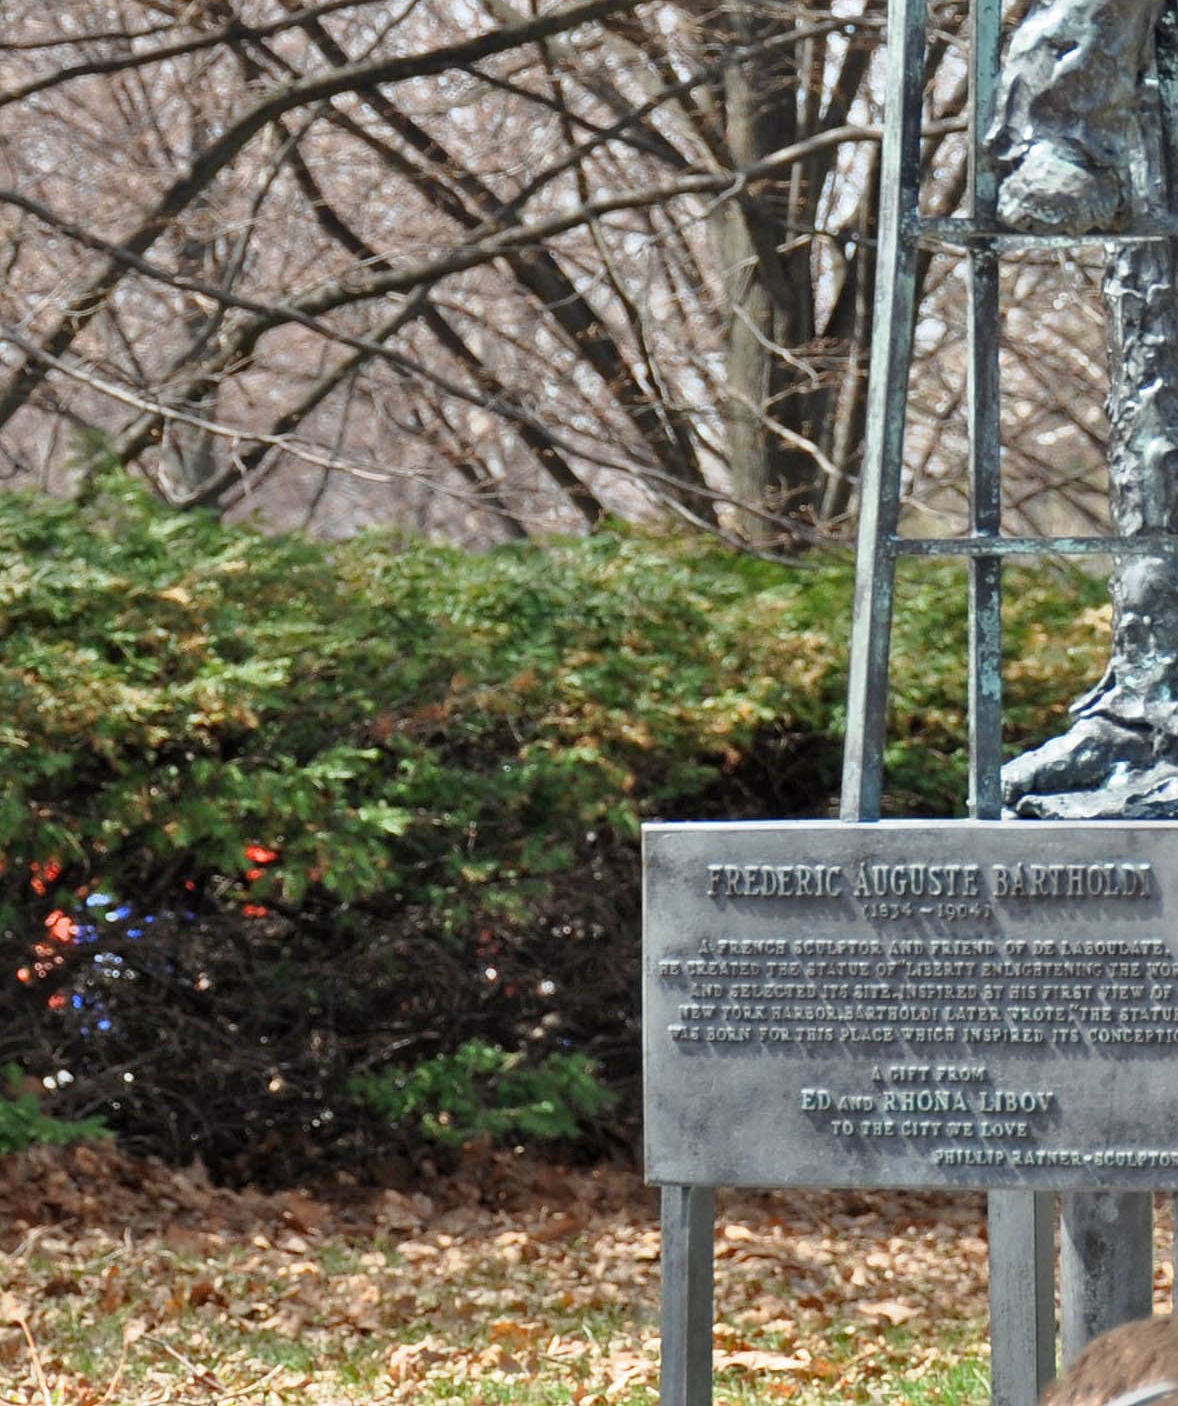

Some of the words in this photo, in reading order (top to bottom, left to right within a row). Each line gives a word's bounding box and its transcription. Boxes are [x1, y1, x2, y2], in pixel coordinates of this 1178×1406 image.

[707, 864, 842, 896] FREDERIC
[853, 862, 979, 896] AUGUSTE
[992, 862, 1151, 896] BARTHOLDI
[718, 939, 786, 955] FRENCH
[793, 939, 881, 955] SCULPTOR
[887, 939, 924, 955] AND
[930, 939, 996, 955] FRIEND
[1004, 940, 1025, 955] OF
[1032, 940, 1055, 955] DE
[658, 961, 681, 977] HE
[686, 961, 761, 977] CREATED
[767, 962, 799, 977] THE
[805, 961, 869, 977] STATUE
[875, 962, 897, 977] OF
[981, 961, 1102, 977] ENLIGHTENING
[1107, 961, 1140, 977] THE
[689, 983, 723, 999] AND
[730, 983, 816, 999] SELECTED
[821, 984, 848, 999] ITS
[983, 984, 1003, 999] BY
[1008, 984, 1036, 999] HIS
[1042, 984, 1093, 999] FIRST
[1098, 984, 1144, 999] VIEW
[1151, 984, 1173, 999] OF
[678, 1004, 716, 1020] NEW
[721, 1005, 765, 1020] YORK
[943, 1005, 1000, 1021] LATER
[667, 1025, 699, 1042] WAS
[706, 1027, 750, 1042] BORN
[759, 1027, 793, 1042] FOR
[796, 1027, 833, 1042] THIS
[840, 1027, 893, 1042] PLACE
[901, 1027, 955, 1042] WHICH
[962, 1027, 1043, 1043] INSPIRED
[1052, 1028, 1079, 1043] ITS
[871, 1066, 881, 1082] A
[889, 1066, 930, 1082] GIFT
[936, 1066, 986, 1082] FROM
[801, 1089, 832, 1111] ED
[837, 1096, 873, 1112] AND
[883, 1090, 967, 1112] RHONA
[979, 1092, 1053, 1112] LIBOV
[831, 1121, 854, 1136] TO
[860, 1121, 893, 1136] THE
[902, 1121, 942, 1136] CITY
[946, 1122, 973, 1137] WE
[980, 1122, 1027, 1137] LOVE
[934, 1149, 1003, 1166] PHILLIP
